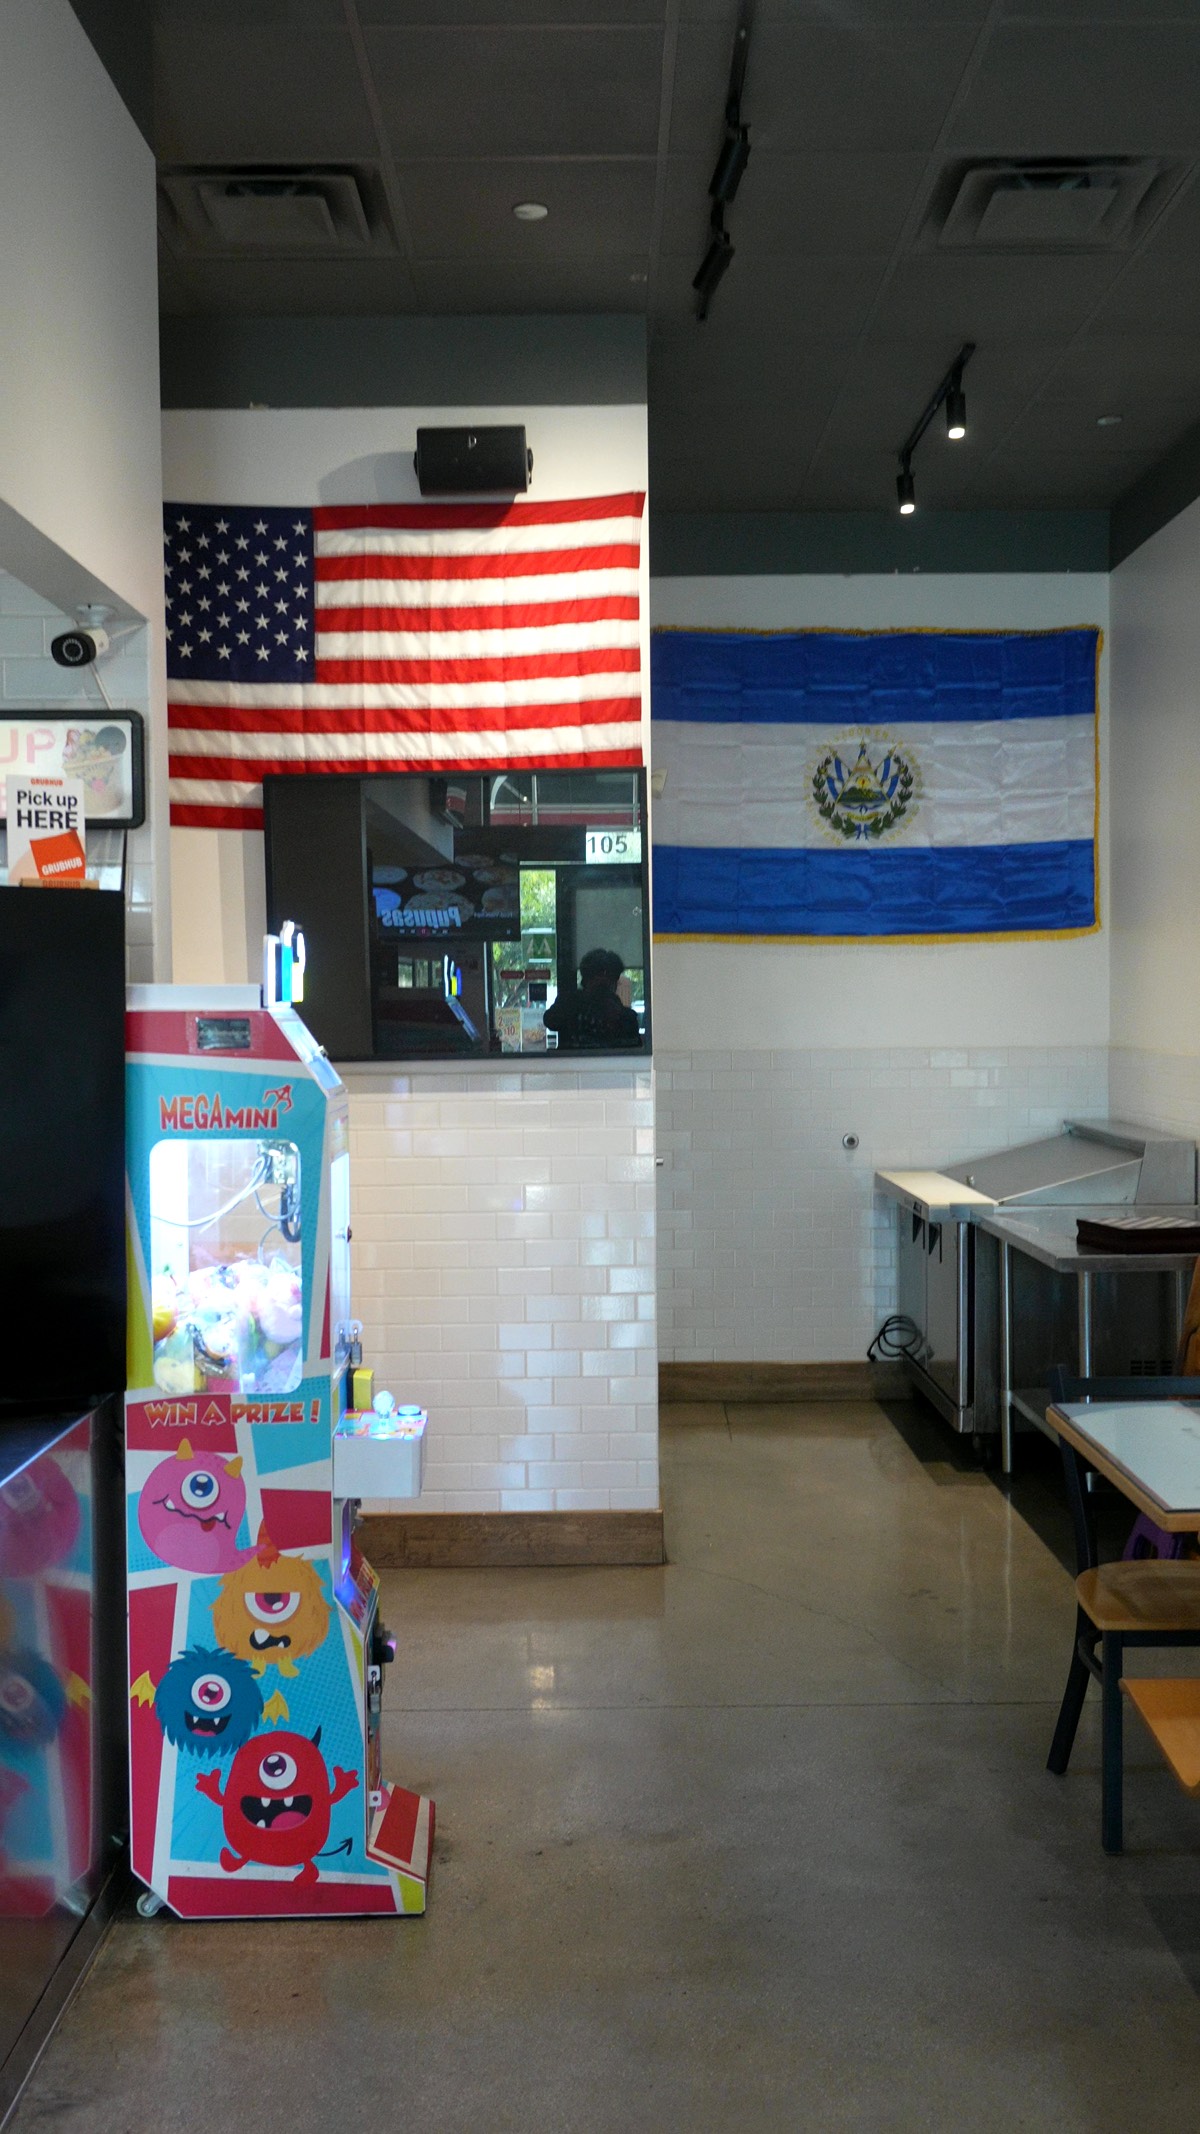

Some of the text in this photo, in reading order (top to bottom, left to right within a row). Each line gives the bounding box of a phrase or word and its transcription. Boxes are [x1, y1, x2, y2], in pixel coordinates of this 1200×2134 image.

[30, 778, 64, 787] GRUBHUB
[17, 790, 52, 806] Pick
[56, 796, 78, 810] up
[17, 810, 79, 830] HERE
[587, 835, 628, 854] 105
[42, 856, 83, 876] GRUBHUB
[143, 1401, 198, 1429] WIN
[200, 1400, 227, 1426] A
